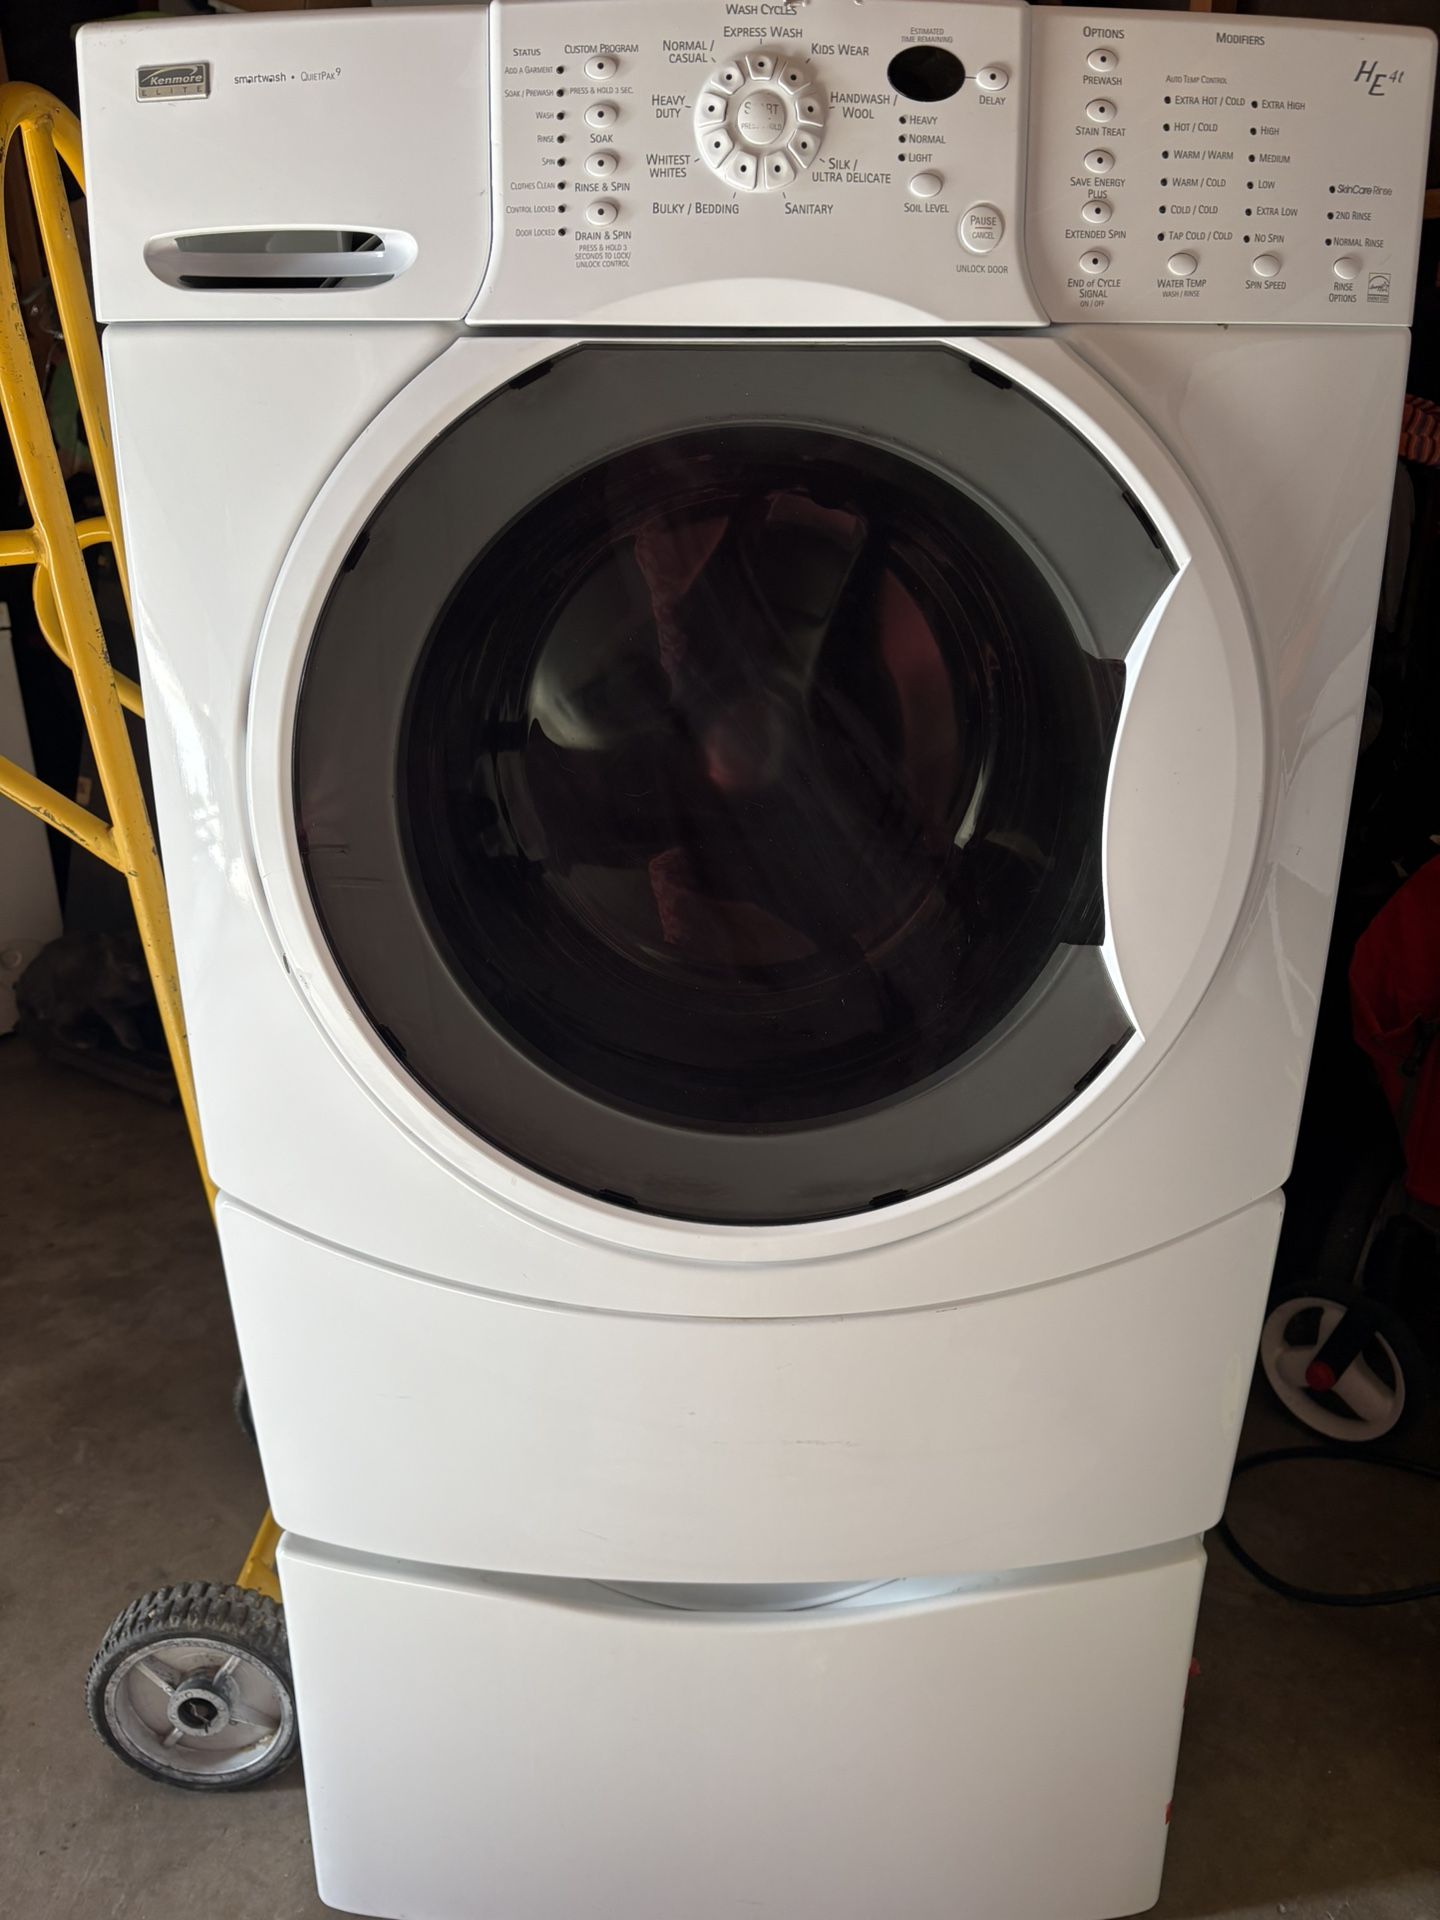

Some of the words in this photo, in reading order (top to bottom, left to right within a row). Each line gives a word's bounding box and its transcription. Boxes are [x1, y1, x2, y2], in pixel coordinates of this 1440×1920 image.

[726, 4, 758, 15] WASH
[760, 4, 798, 16] CYCLES
[723, 26, 767, 38] EXPRESS
[770, 27, 803, 38] WASH
[910, 27, 944, 35] ESTIMATED
[1083, 26, 1125, 39] OPTIONS
[1216, 32, 1265, 46] MODIFIERS
[564, 44, 597, 54] CUSTOM
[600, 43, 638, 53] PROGRAM
[662, 40, 707, 51] NORMAL
[811, 43, 834, 55] KIDS
[838, 44, 869, 56] WEAR
[513, 48, 541, 56] STATUS
[669, 53, 708, 63] CASUAL
[504, 66, 518, 74] ADD
[524, 66, 553, 74] GARMENT
[150, 75, 203, 86] Kenmore
[1083, 75, 1122, 85] PREWASH
[1165, 75, 1182, 83] AUTO
[1184, 75, 1199, 83] TEMP
[1200, 75, 1227, 84] CONTROL
[141, 86, 203, 96] ELITE
[504, 89, 521, 97] SOAK
[526, 89, 554, 97] PREWASH
[651, 95, 686, 106] HEAVY
[830, 92, 890, 105] HANDWASH
[979, 95, 1006, 105] DELAY
[1175, 96, 1199, 105] EXTRA
[1202, 96, 1218, 105] HOT
[1225, 96, 1246, 106] COLD
[1261, 100, 1285, 109] EXTRA
[1287, 100, 1306, 110] HIGH
[536, 111, 554, 119] WASH
[656, 108, 681, 118] DUTY
[842, 106, 874, 119] WOOL
[909, 115, 938, 125] HEAVY
[1075, 126, 1099, 136] STAIN
[1102, 127, 1126, 136] TREAT
[1174, 122, 1190, 131] HOT
[1198, 122, 1218, 132] COLD
[1260, 126, 1280, 135] HIGH
[537, 135, 555, 143] RINSE
[590, 133, 613, 144] SOAK
[909, 134, 946, 144] NORMAL
[646, 154, 690, 166] WHITEST
[908, 153, 932, 163] LIGHT
[1173, 150, 1200, 159] WARM
[1208, 150, 1234, 160] WARM
[1259, 154, 1291, 163] MEDIUM
[541, 158, 555, 166] SPIN
[829, 158, 851, 170] SILK
[649, 167, 687, 178] WHITES
[812, 172, 842, 183] ULTRA
[846, 173, 891, 184] DELICATE
[1070, 177, 1091, 187] SAVE
[1094, 177, 1126, 187] ENERGY
[1172, 178, 1198, 187] WARM
[1206, 178, 1226, 187] COLD
[510, 182, 535, 190] CLOTHES
[536, 181, 555, 189] CLEAN
[575, 183, 599, 192] RINSE
[611, 182, 630, 191] SPIN
[1258, 180, 1275, 189] LOW
[1087, 189, 1108, 199] PLUS
[533, 205, 556, 213] LOCKED
[652, 202, 684, 214] BULKY
[695, 203, 739, 214] BEDDING
[785, 203, 833, 215] SANITARY
[904, 202, 922, 213] SOIL
[925, 203, 949, 213] LEVEL
[1170, 205, 1190, 214] COLD
[1198, 205, 1218, 214] COLD
[1256, 207, 1279, 216] EXTRA
[1281, 207, 1298, 216] LOW
[970, 215, 997, 226] PAUSE
[1335, 211, 1350, 220] 2ND
[1352, 211, 1372, 221] RINSE
[515, 229, 532, 237] DOOR
[534, 228, 556, 236] LOCKED
[575, 231, 601, 241] DRAIN
[612, 230, 632, 240] SPIN
[972, 231, 995, 239] CANCEL
[1065, 229, 1106, 239] EXTENDED
[1108, 229, 1126, 239] SPIN
[1169, 231, 1183, 240] TAP
[1185, 231, 1205, 240] COLD
[1213, 231, 1233, 240] COLD
[1254, 233, 1266, 243] NO
[1267, 234, 1285, 243] SPIN
[1333, 237, 1362, 247] NORMAL
[1365, 237, 1384, 248] RINSE
[614, 252, 631, 260] LOCK/
[602, 260, 630, 268] CONTROL
[956, 264, 985, 273] UNLOCK
[987, 265, 1008, 274] DOOR
[1067, 278, 1084, 288] END
[1086, 279, 1094, 288] of
[1097, 278, 1121, 288] CYCLE
[1157, 278, 1184, 288] WATER
[1186, 279, 1206, 288] TEMP
[1245, 280, 1262, 289] SPIN
[1264, 280, 1287, 290] SPEED
[1333, 282, 1354, 291] RINSE
[1079, 289, 1108, 298] SIGNAL
[1328, 293, 1357, 303] OPTIONS
